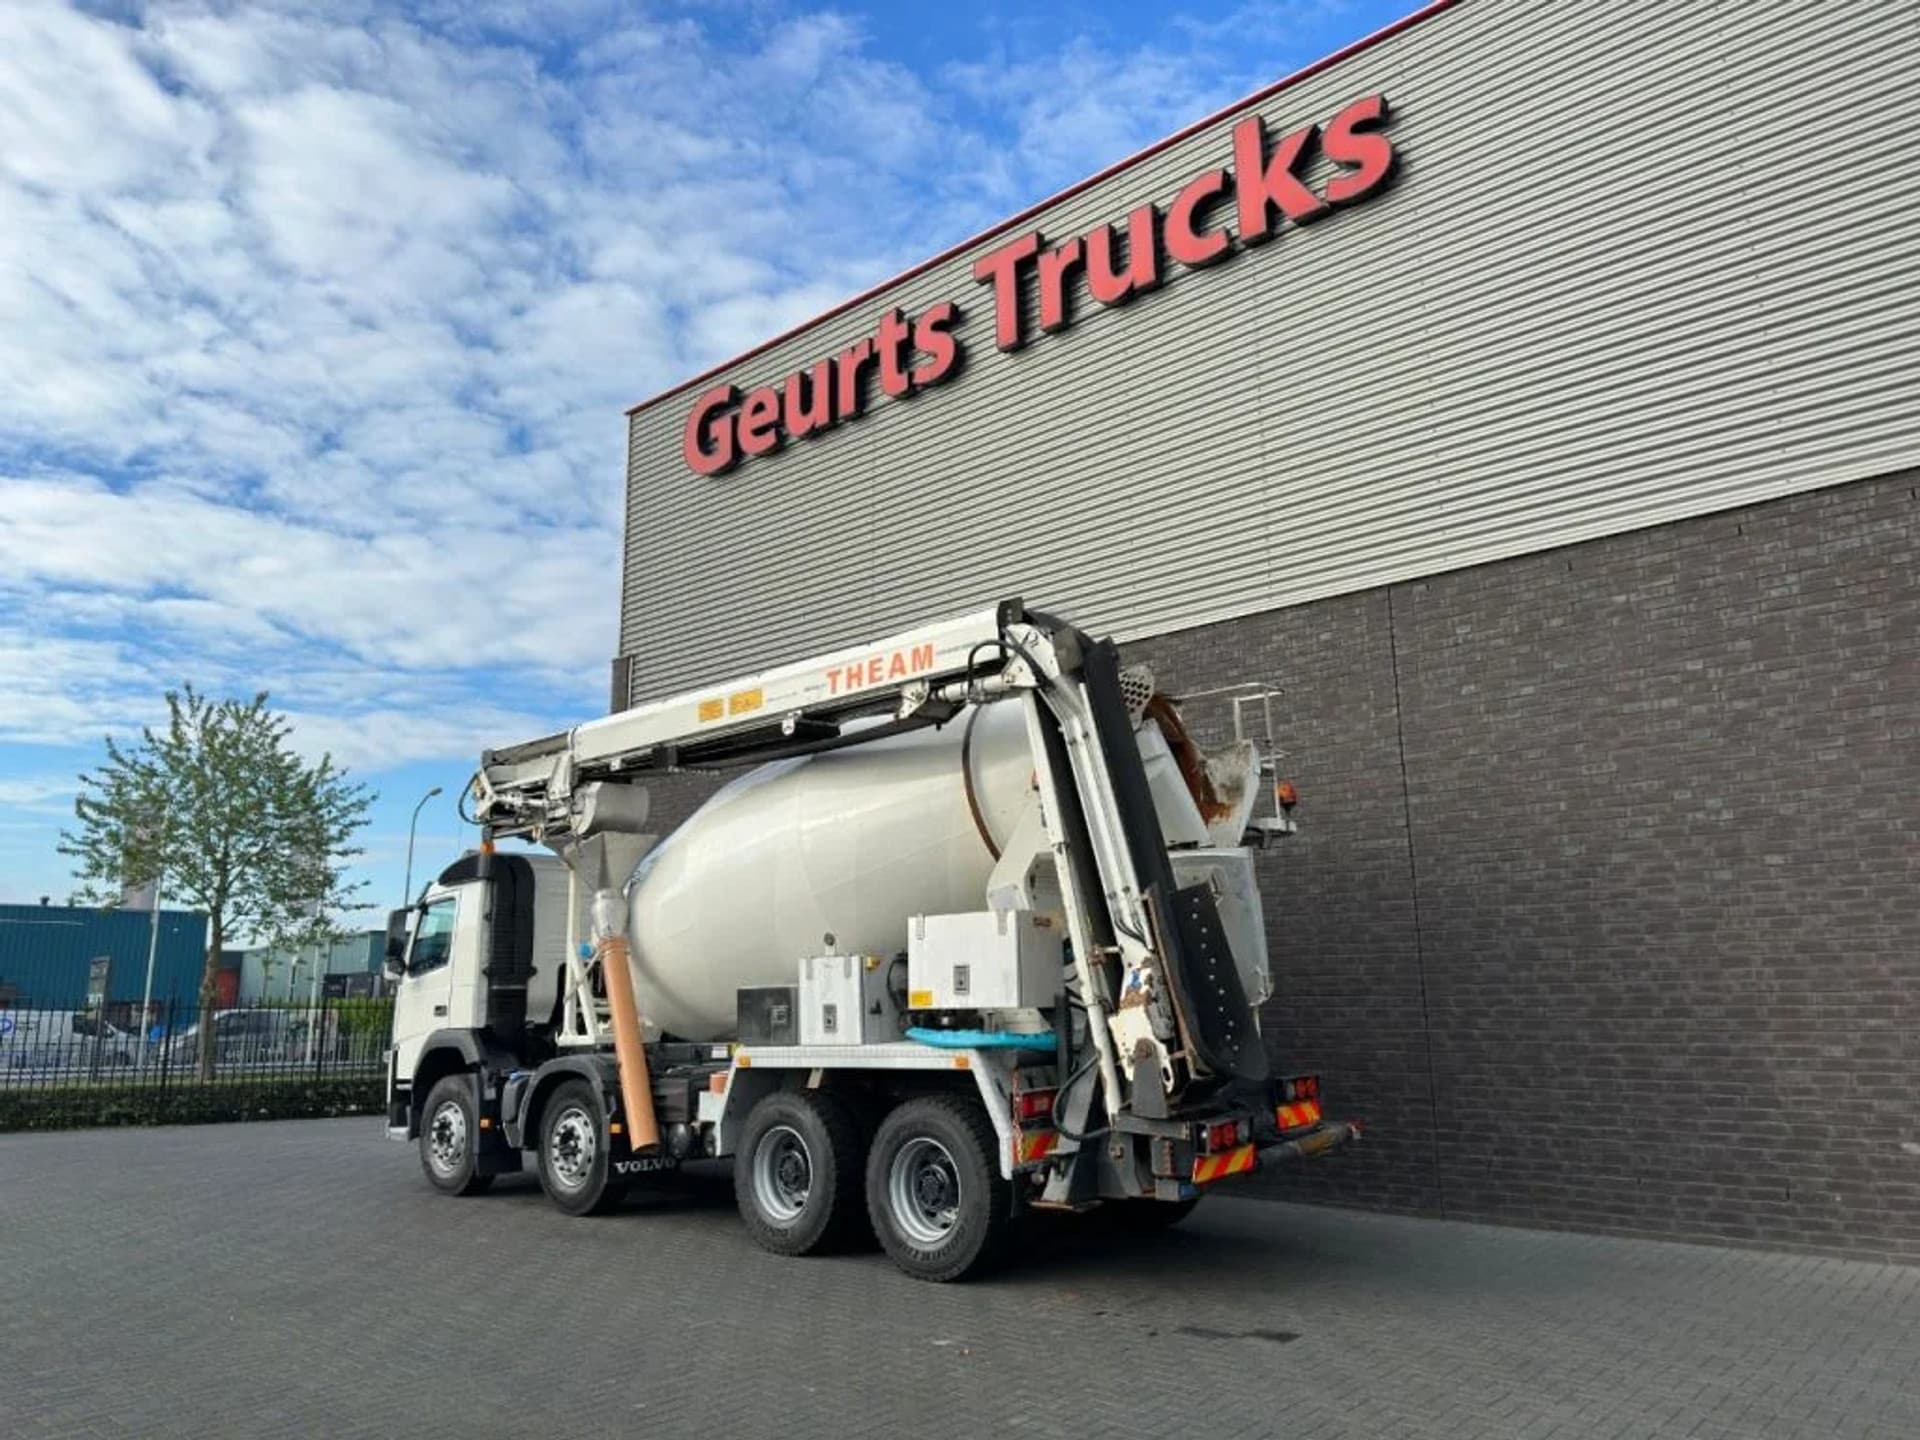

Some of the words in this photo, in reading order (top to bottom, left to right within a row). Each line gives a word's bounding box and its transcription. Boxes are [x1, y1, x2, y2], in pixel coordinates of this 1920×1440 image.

[682, 302, 958, 476] Geurts
[973, 94, 1395, 352] Trucks
[826, 643, 934, 694] THEAM
[615, 1156, 676, 1174] VOLVO
